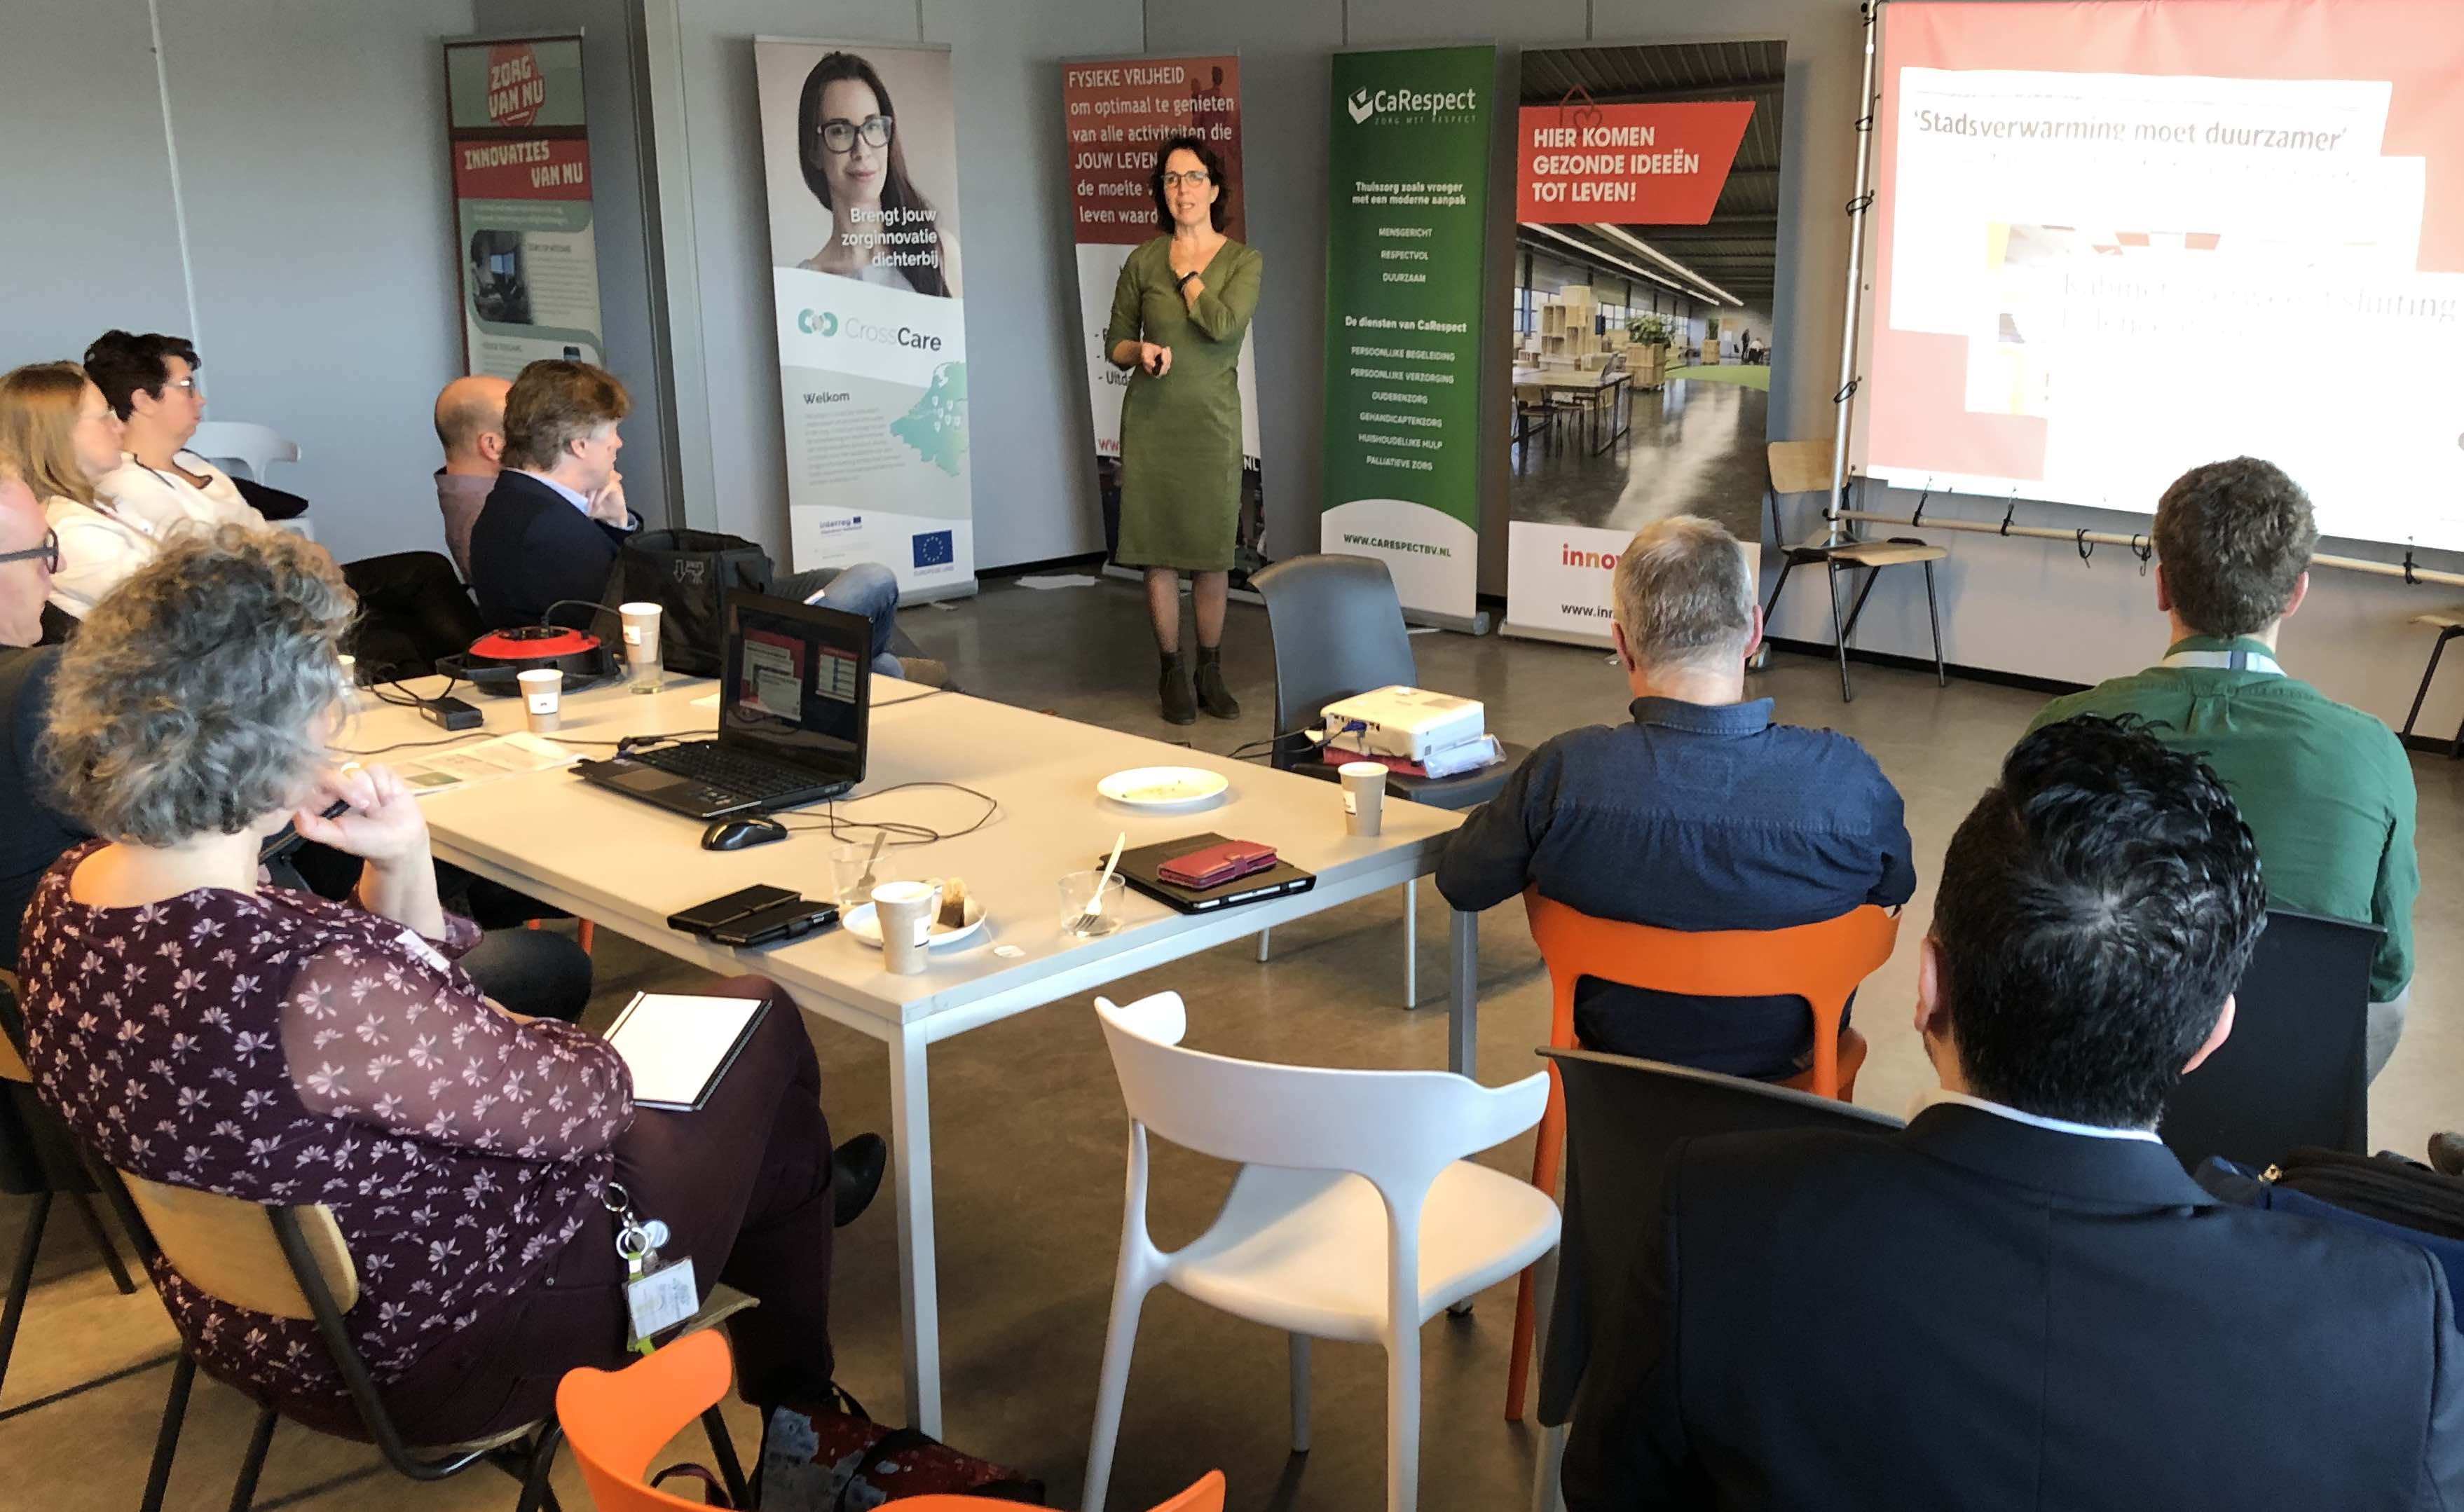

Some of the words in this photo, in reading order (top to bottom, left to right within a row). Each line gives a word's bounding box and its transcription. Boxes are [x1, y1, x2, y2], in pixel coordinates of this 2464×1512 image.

[491, 55, 531, 90] ZORG
[1069, 69, 1121, 88] FYSIEKE
[1124, 67, 1184, 85] VRIJHEID
[489, 86, 519, 118] VAN
[522, 79, 544, 107] NU
[1071, 102, 1090, 116] om
[1095, 97, 1151, 118] optimaal
[1156, 98, 1169, 112] te
[1174, 95, 1234, 116] genieten
[1375, 88, 1476, 116] CaRespect
[1072, 129, 1096, 142] van
[1100, 125, 1123, 142] alle
[1211, 123, 1232, 141] die
[1533, 128, 1577, 148] HIER
[1582, 126, 1655, 146] KOMEN
[465, 140, 550, 170] INNOVATIES
[1075, 153, 1113, 170] JOUW
[1117, 152, 1158, 169] LEVEN
[1533, 154, 1624, 175] GEZONDE
[1631, 149, 1699, 175] IDEEËN
[531, 165, 560, 188] VAN
[563, 163, 583, 184] NU
[1077, 179, 1094, 196] de
[1099, 179, 1143, 196] moeite
[1356, 181, 1399, 195] Thuiszorg
[1402, 181, 1425, 192] zoals
[1427, 183, 1463, 194] vroeger
[1532, 181, 1568, 202] TOT
[1571, 181, 1637, 202] LEVEN!
[1352, 195, 1369, 204] met
[1389, 194, 1430, 205] moderne
[1432, 194, 1466, 207] aanpak
[851, 207, 900, 226] Brengt
[901, 207, 937, 225] jouw
[1079, 206, 1115, 223] leven
[842, 228, 937, 249] zorginnovatie
[1378, 228, 1432, 238] MENSGERICHT
[872, 250, 939, 269] dichterbij
[1381, 250, 1429, 260] RESPECTVOL
[1383, 273, 1426, 282] DUURZAAM
[1345, 316, 1357, 327] De
[1359, 316, 1397, 329] diensten
[1399, 320, 1415, 329] van
[1417, 319, 1467, 334] CaRespect
[803, 392, 850, 404] Welkom
[1422, 439, 1443, 450] HULP
[1367, 455, 1410, 468] PALLIATIEVE
[1412, 460, 1432, 471] ZORG
[1343, 533, 1451, 557] WWW.CARESPECTBV.NL
